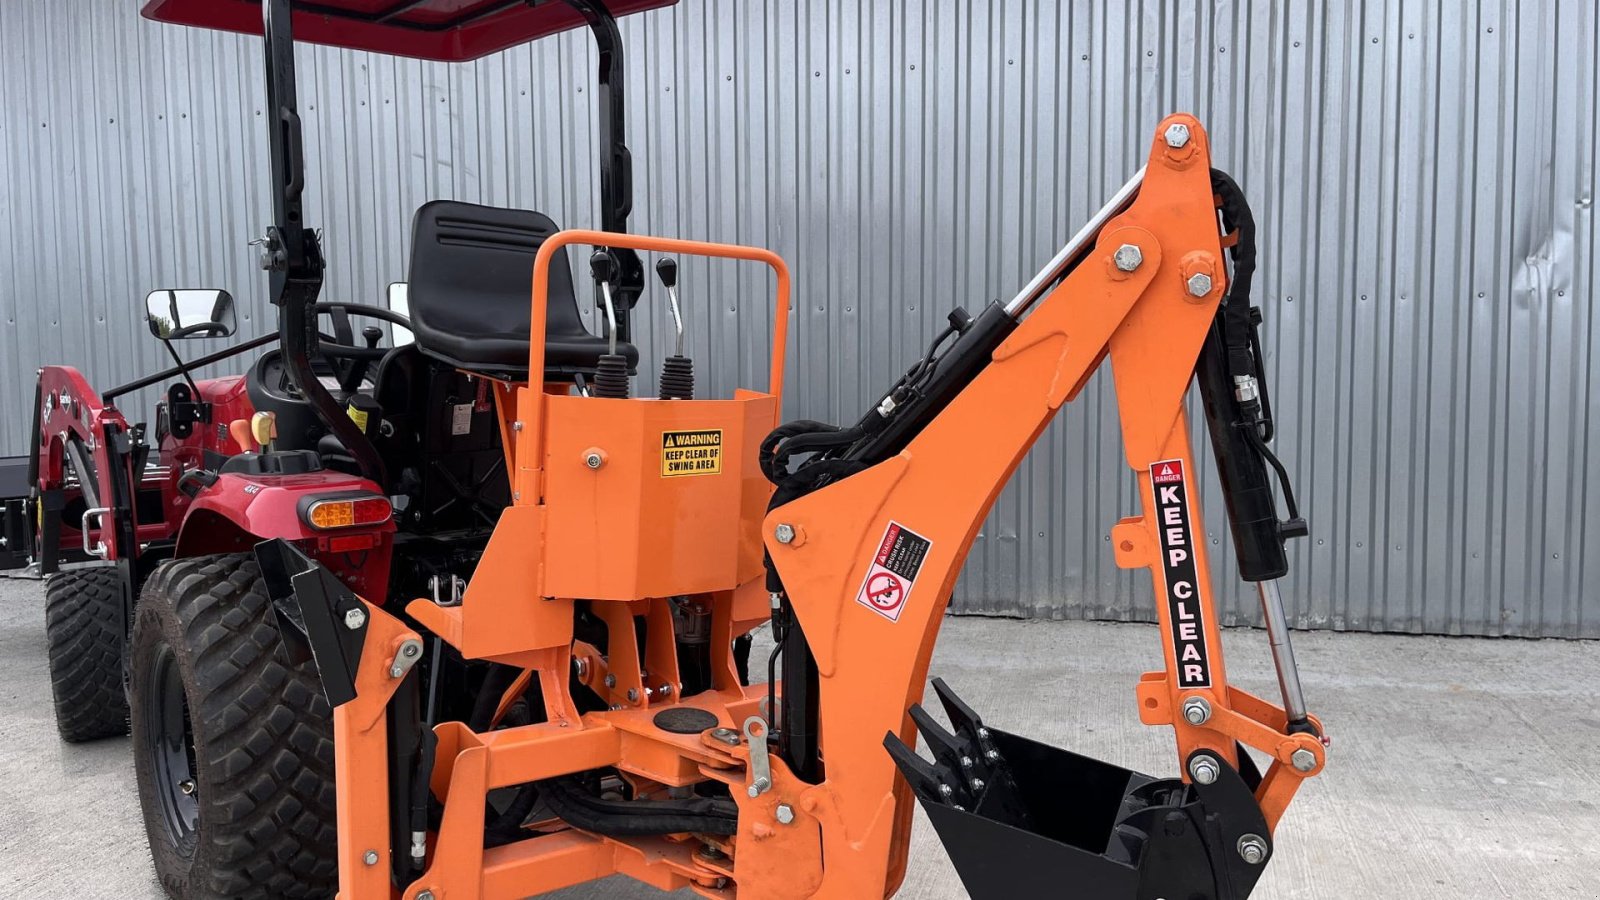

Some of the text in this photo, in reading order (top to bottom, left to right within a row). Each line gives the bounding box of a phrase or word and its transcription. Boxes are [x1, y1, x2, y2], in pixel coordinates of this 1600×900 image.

[675, 433, 720, 446] WARNING
[665, 448, 719, 460] KEEP CLEAR OF
[668, 459, 715, 472] SWING AREA
[1154, 474, 1181, 483] DANGER
[883, 530, 896, 554] DANGER
[887, 535, 905, 568] CRUSH RISK
[1160, 485, 1204, 683] KEEP CLEAR
